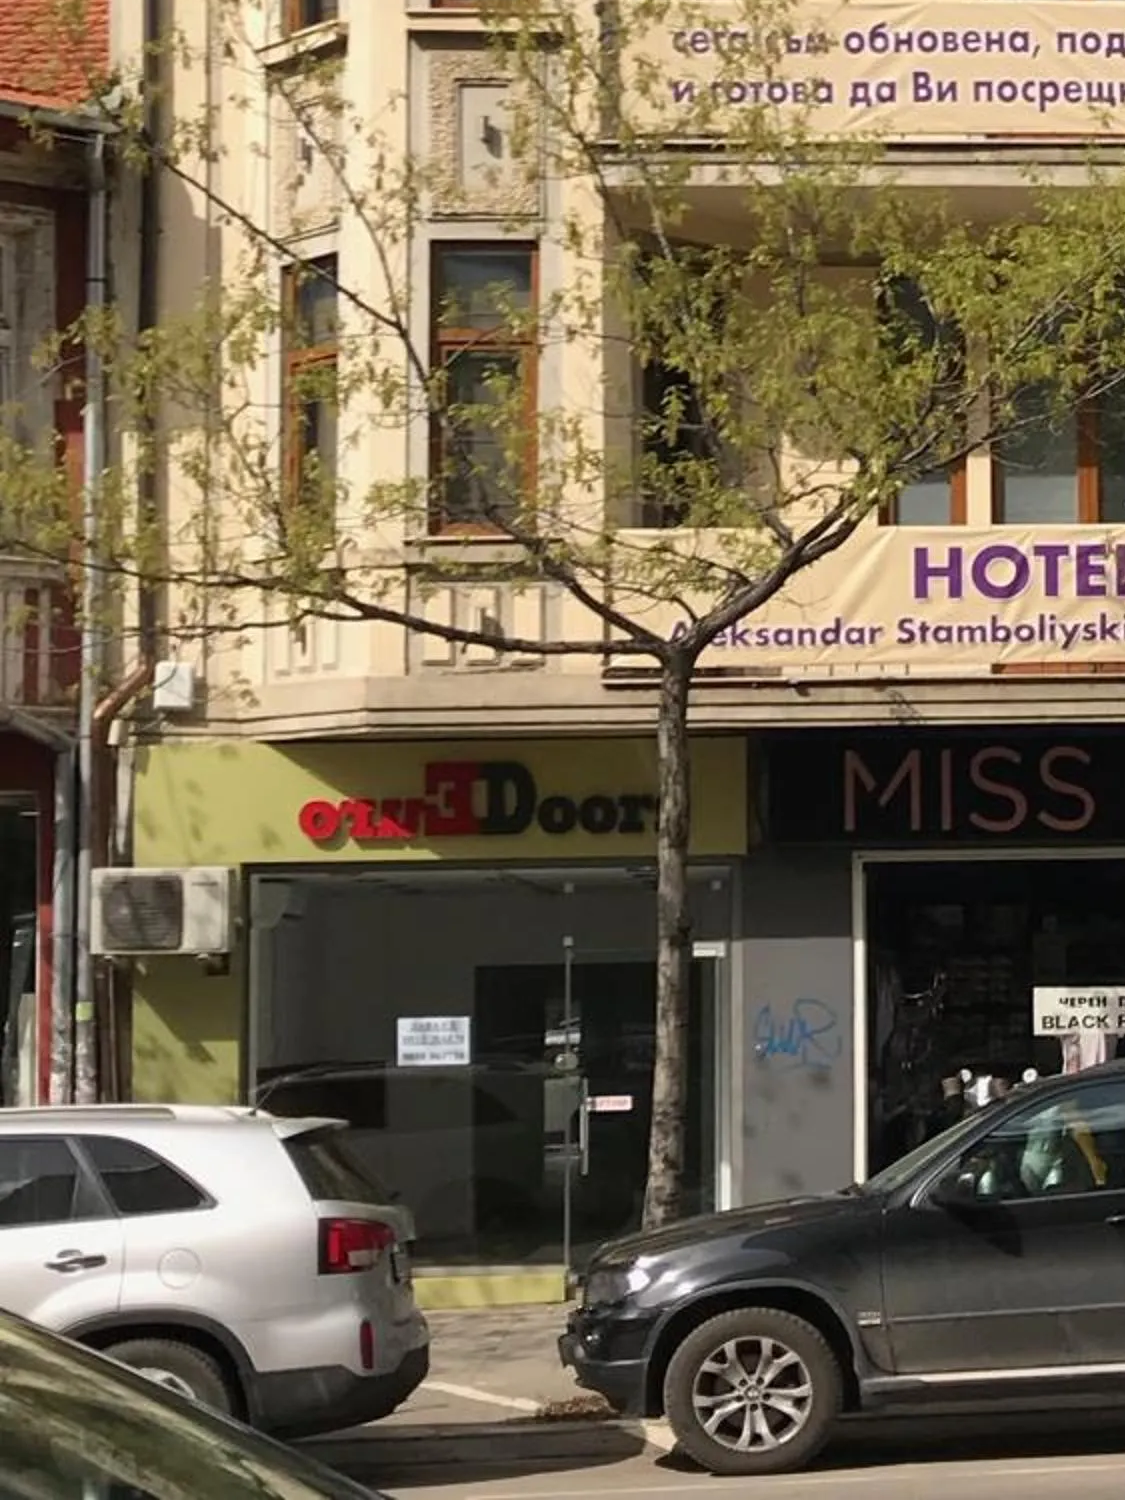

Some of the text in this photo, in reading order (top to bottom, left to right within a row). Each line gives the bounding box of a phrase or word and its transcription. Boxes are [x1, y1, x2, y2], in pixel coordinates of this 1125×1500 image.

[844, 22, 1041, 58] обновена,
[672, 81, 695, 103] и
[710, 81, 833, 104] готова
[849, 80, 897, 107] да
[912, 72, 958, 102] Ви
[670, 616, 884, 647] Aeksandar
[480, 761, 662, 836] Door
[843, 746, 1095, 832] MISS
[1041, 1015, 1109, 1029] BLACK
